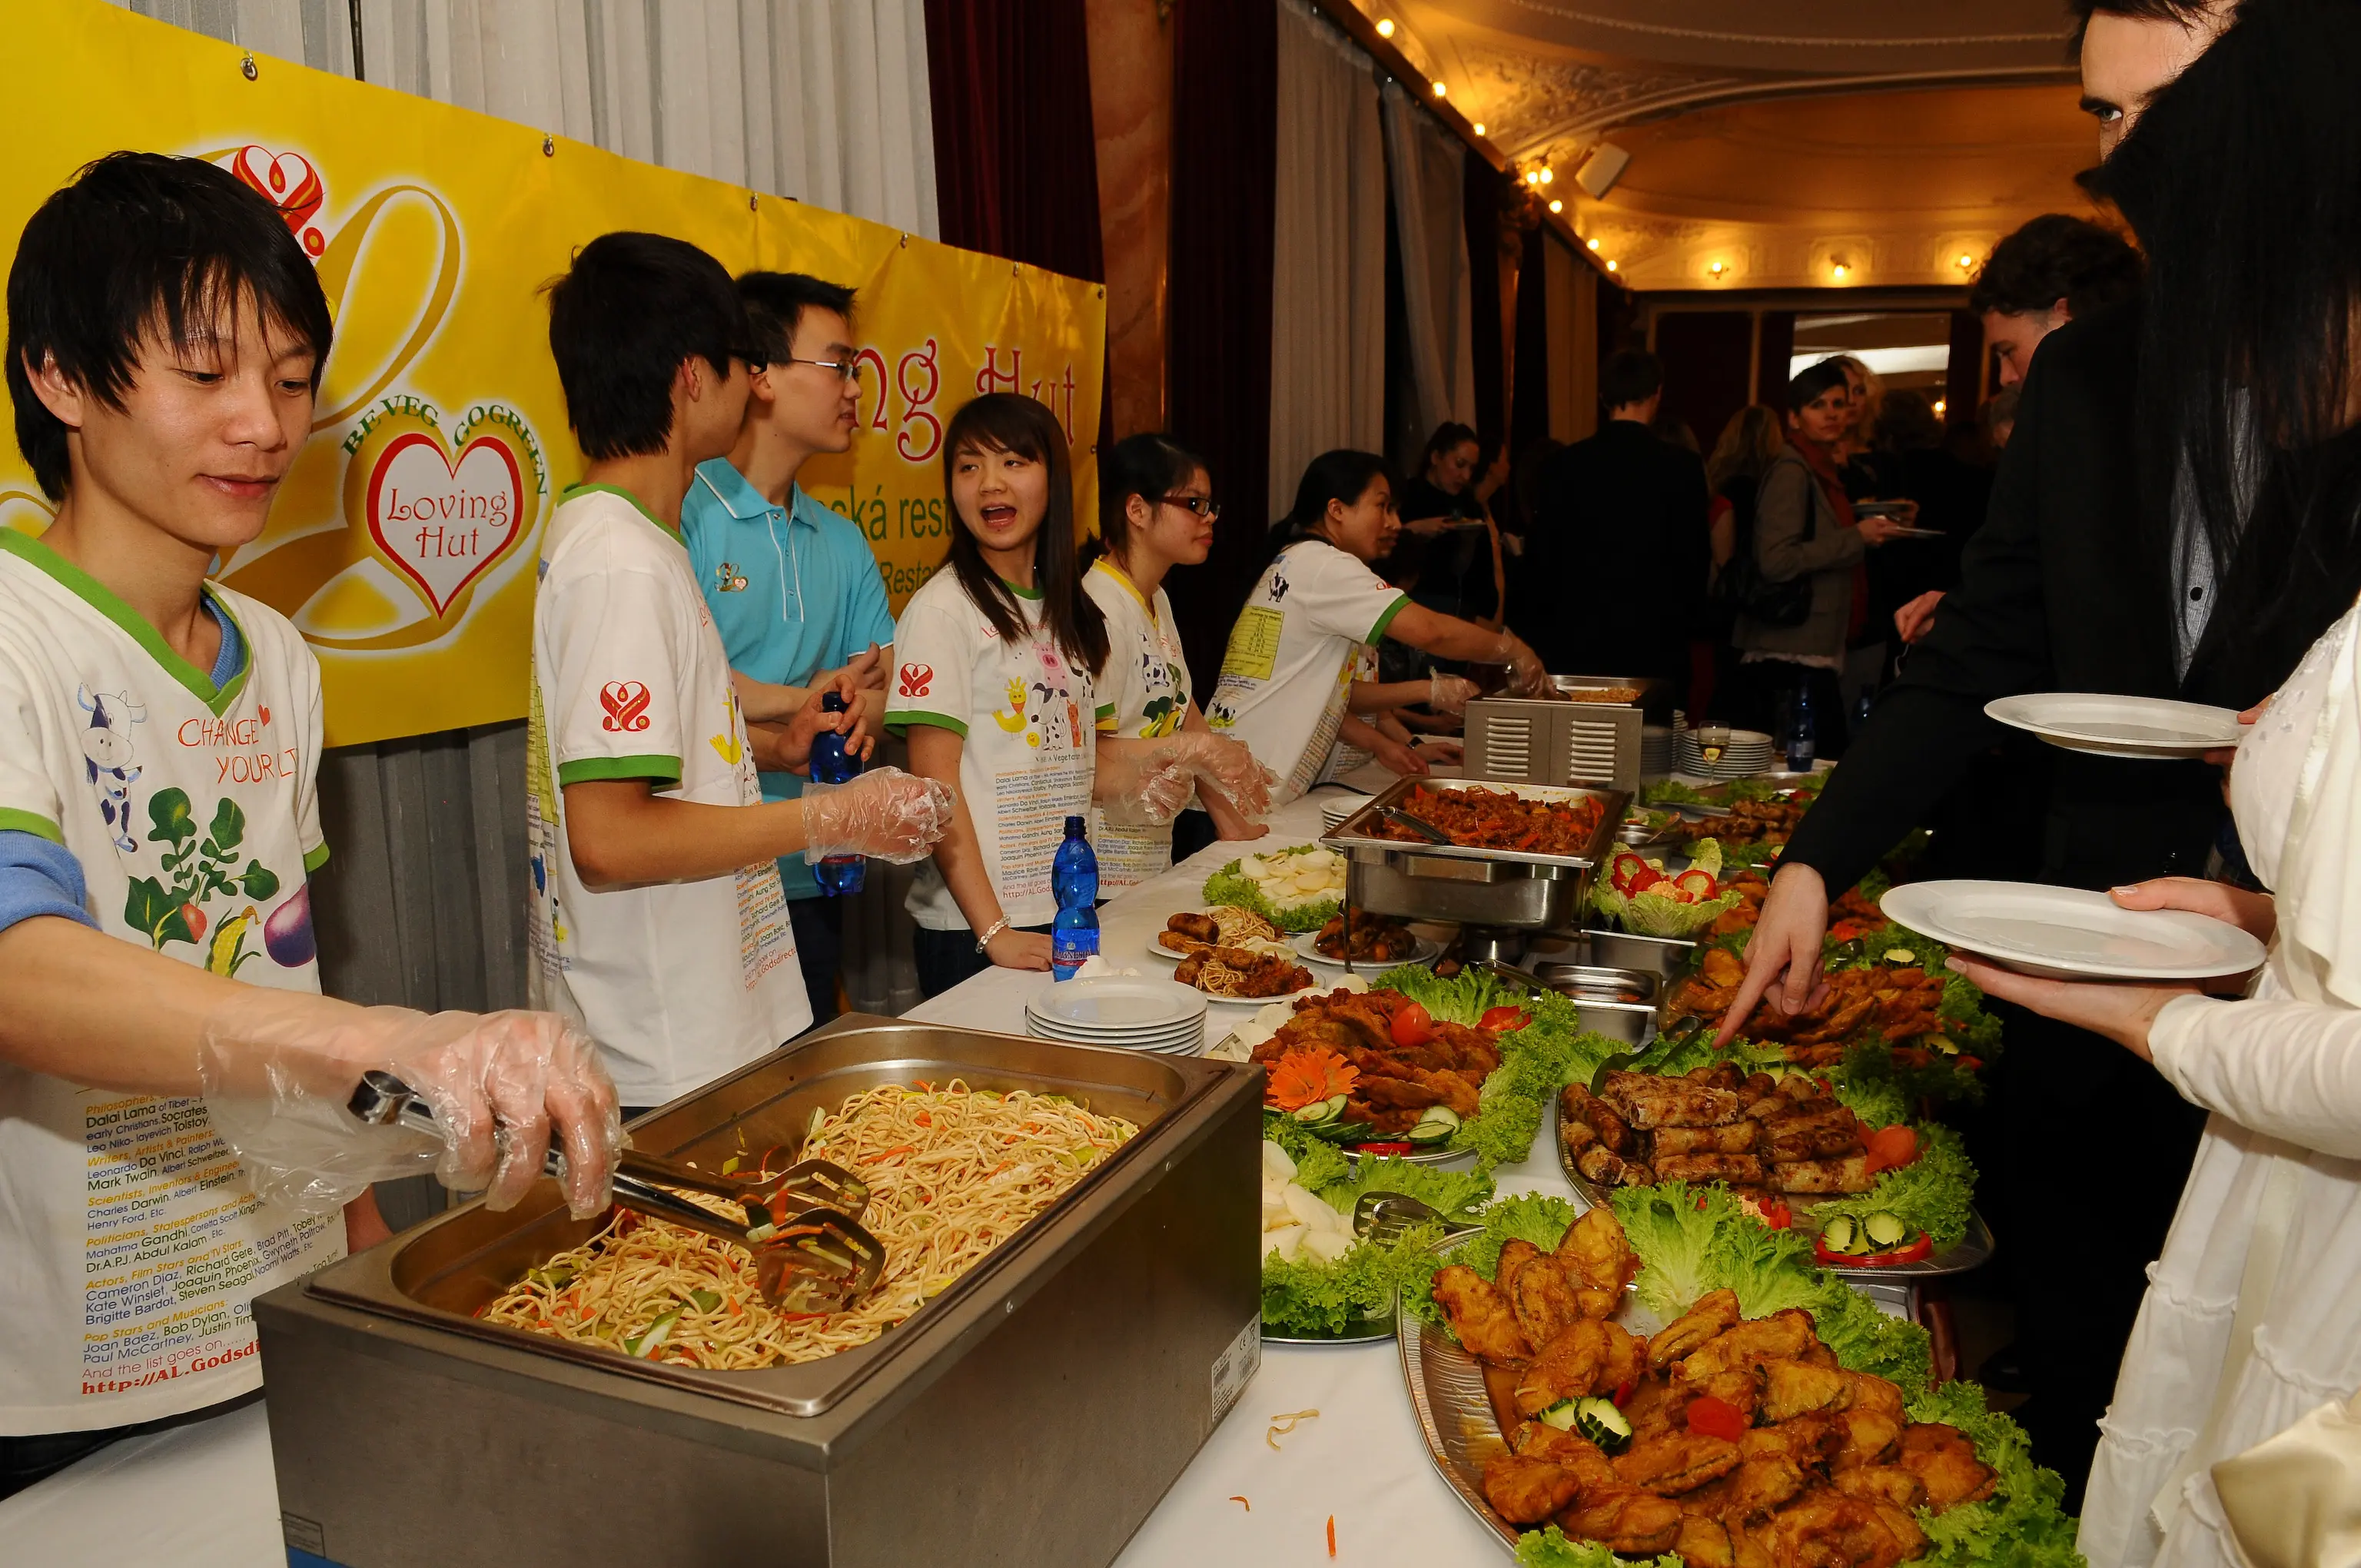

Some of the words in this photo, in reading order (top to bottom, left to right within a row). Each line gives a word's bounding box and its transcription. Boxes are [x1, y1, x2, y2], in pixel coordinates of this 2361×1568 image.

[852, 338, 943, 461] ng
[340, 409, 381, 457] BE
[380, 394, 439, 428] VEG
[387, 488, 508, 527] Loving
[899, 498, 951, 539] rest
[416, 526, 479, 558] Hut
[880, 561, 937, 594] Resta
[178, 718, 260, 748] CHANGE
[215, 752, 273, 784] YOUR
[1003, 885, 1052, 898] http://AL.Gods
[86, 1111, 120, 1128] Dalai
[125, 1105, 155, 1120] Lama
[159, 1102, 167, 1112] of
[168, 1098, 189, 1109] Tibet
[86, 1128, 113, 1141] early
[161, 1105, 208, 1124] Socrates
[88, 1142, 106, 1153] Leo
[110, 1136, 134, 1148] Niko-
[88, 1153, 131, 1168] Writers,
[135, 1144, 164, 1158] Artists
[88, 1163, 137, 1179] Leonardo
[140, 1157, 157, 1168] Da
[188, 1141, 211, 1154] Ralph
[88, 1177, 121, 1191] Mark
[162, 1161, 185, 1174] Albert
[88, 1189, 144, 1206] Scientists,
[149, 1178, 191, 1194] Inventors
[88, 1204, 128, 1219] Charles
[174, 1186, 197, 1199] Albert
[88, 1219, 118, 1230] Henry
[122, 1214, 147, 1225] Ford,
[151, 1209, 167, 1218] Etc.
[87, 1230, 148, 1247] Politicians,
[154, 1208, 218, 1233] Statespersons
[221, 1200, 236, 1211] and
[87, 1242, 138, 1259] Mahatma
[191, 1219, 218, 1233] Coretta
[220, 1211, 237, 1224] Scott
[86, 1282, 148, 1301] Cameron
[154, 1271, 181, 1285] Diaz,
[187, 1256, 229, 1275] Richard
[231, 1248, 255, 1261] Gere,
[257, 1237, 276, 1251] Brad
[278, 1229, 292, 1240] Pitt,
[293, 1216, 315, 1232] Tobey
[86, 1275, 127, 1289] Actors,
[132, 1268, 152, 1280] Film
[157, 1259, 184, 1273] Stars
[188, 1253, 209, 1264] and
[211, 1247, 221, 1257] TV
[134, 1246, 169, 1261] Abdul
[86, 1301, 117, 1313] Kate
[121, 1287, 168, 1307] Winslet,
[172, 1272, 221, 1291] Joaquin
[226, 1257, 261, 1277] Phoenix,
[263, 1237, 297, 1259] Gwyneth
[85, 1332, 108, 1341] Pop
[113, 1326, 142, 1337] Stars
[147, 1316, 169, 1330] and
[173, 1299, 227, 1321] Musicians:
[86, 1311, 131, 1325] Brigitte
[135, 1297, 177, 1316] Bardot,
[179, 1284, 214, 1301] Steven
[84, 1340, 118, 1352] Joan
[124, 1332, 159, 1347] Baez,
[164, 1323, 188, 1336] Bob
[192, 1311, 230, 1328] Dylan,
[84, 1352, 112, 1363] Paul
[118, 1333, 194, 1359] McCartney,
[198, 1320, 231, 1337] Justin
[235, 1314, 253, 1326] Tim
[82, 1367, 112, 1379] And
[118, 1363, 141, 1375] the
[146, 1356, 162, 1369] list
[168, 1347, 201, 1365] goes
[82, 1339, 261, 1394] http://AL.Godsdi
